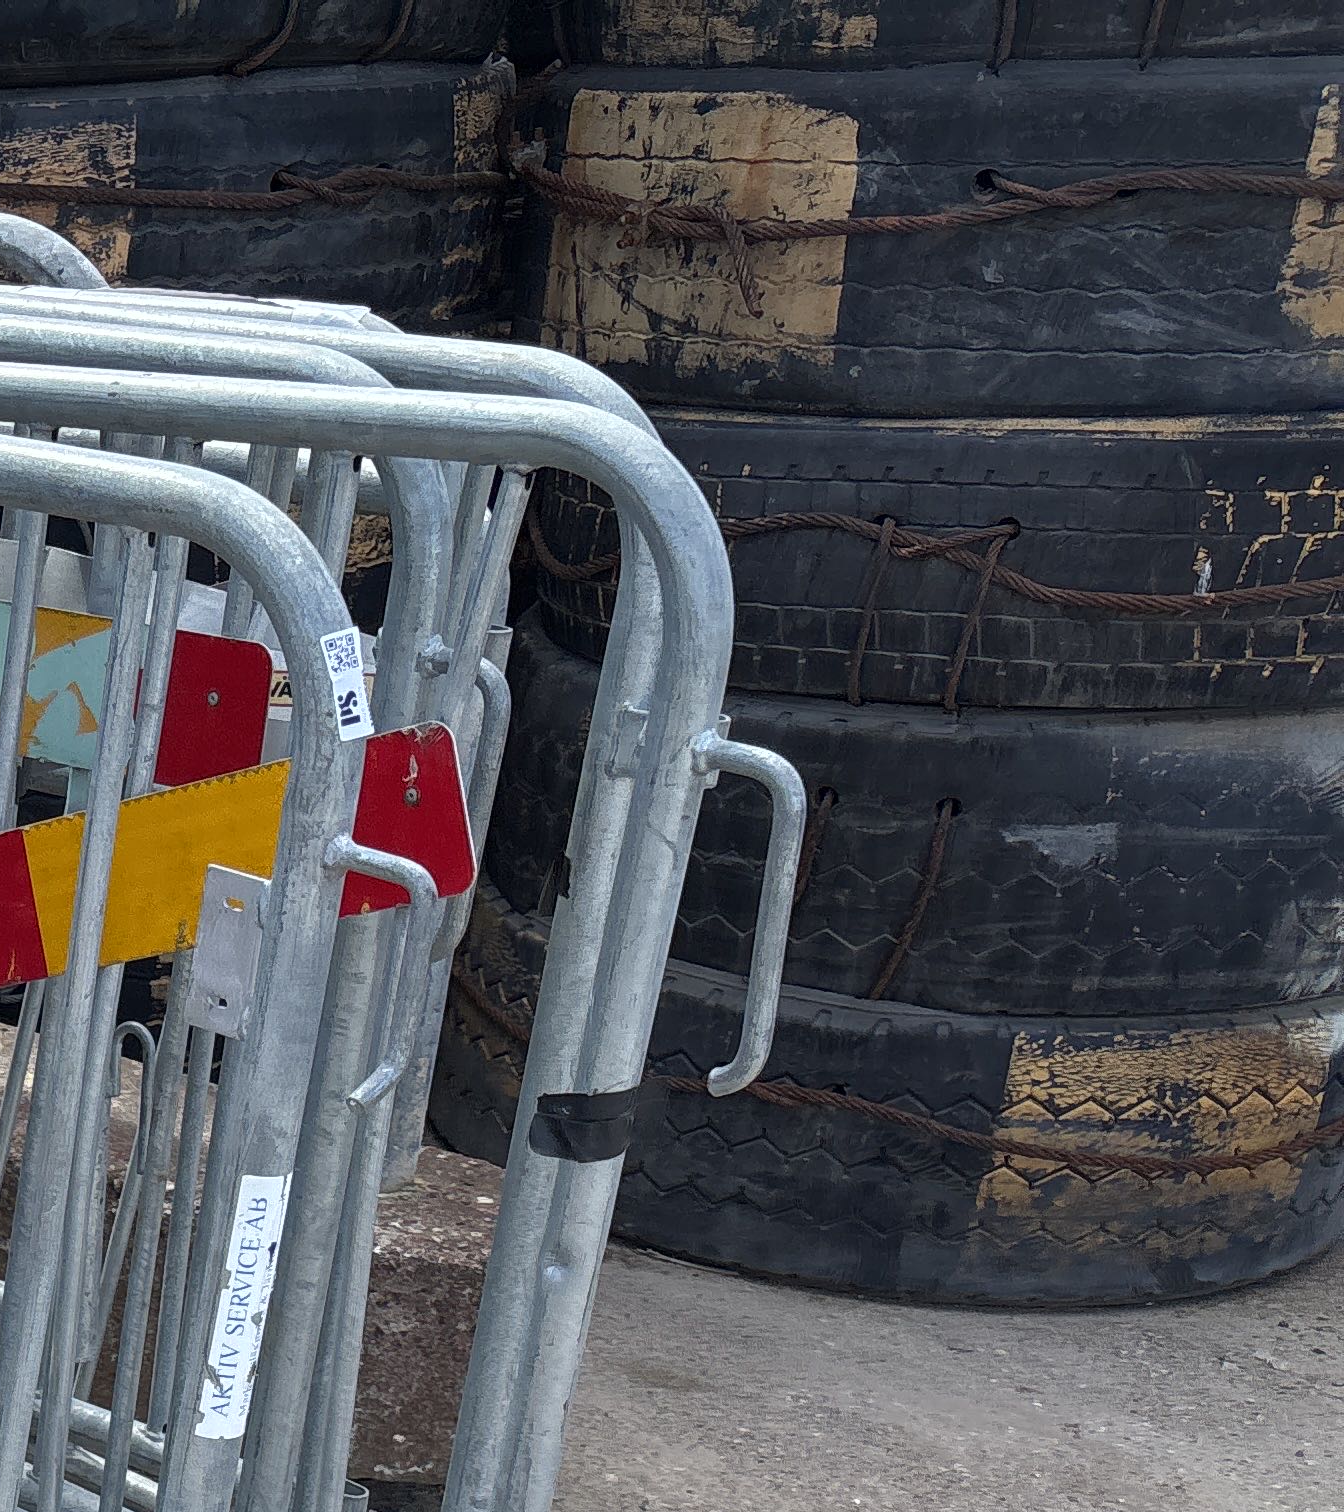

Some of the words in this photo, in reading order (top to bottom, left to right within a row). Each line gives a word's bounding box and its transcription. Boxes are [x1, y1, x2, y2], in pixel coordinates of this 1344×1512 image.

[210, 1343, 239, 1417] AKTIV
[225, 1238, 260, 1336] SERVICE
[246, 1198, 268, 1231] AB
